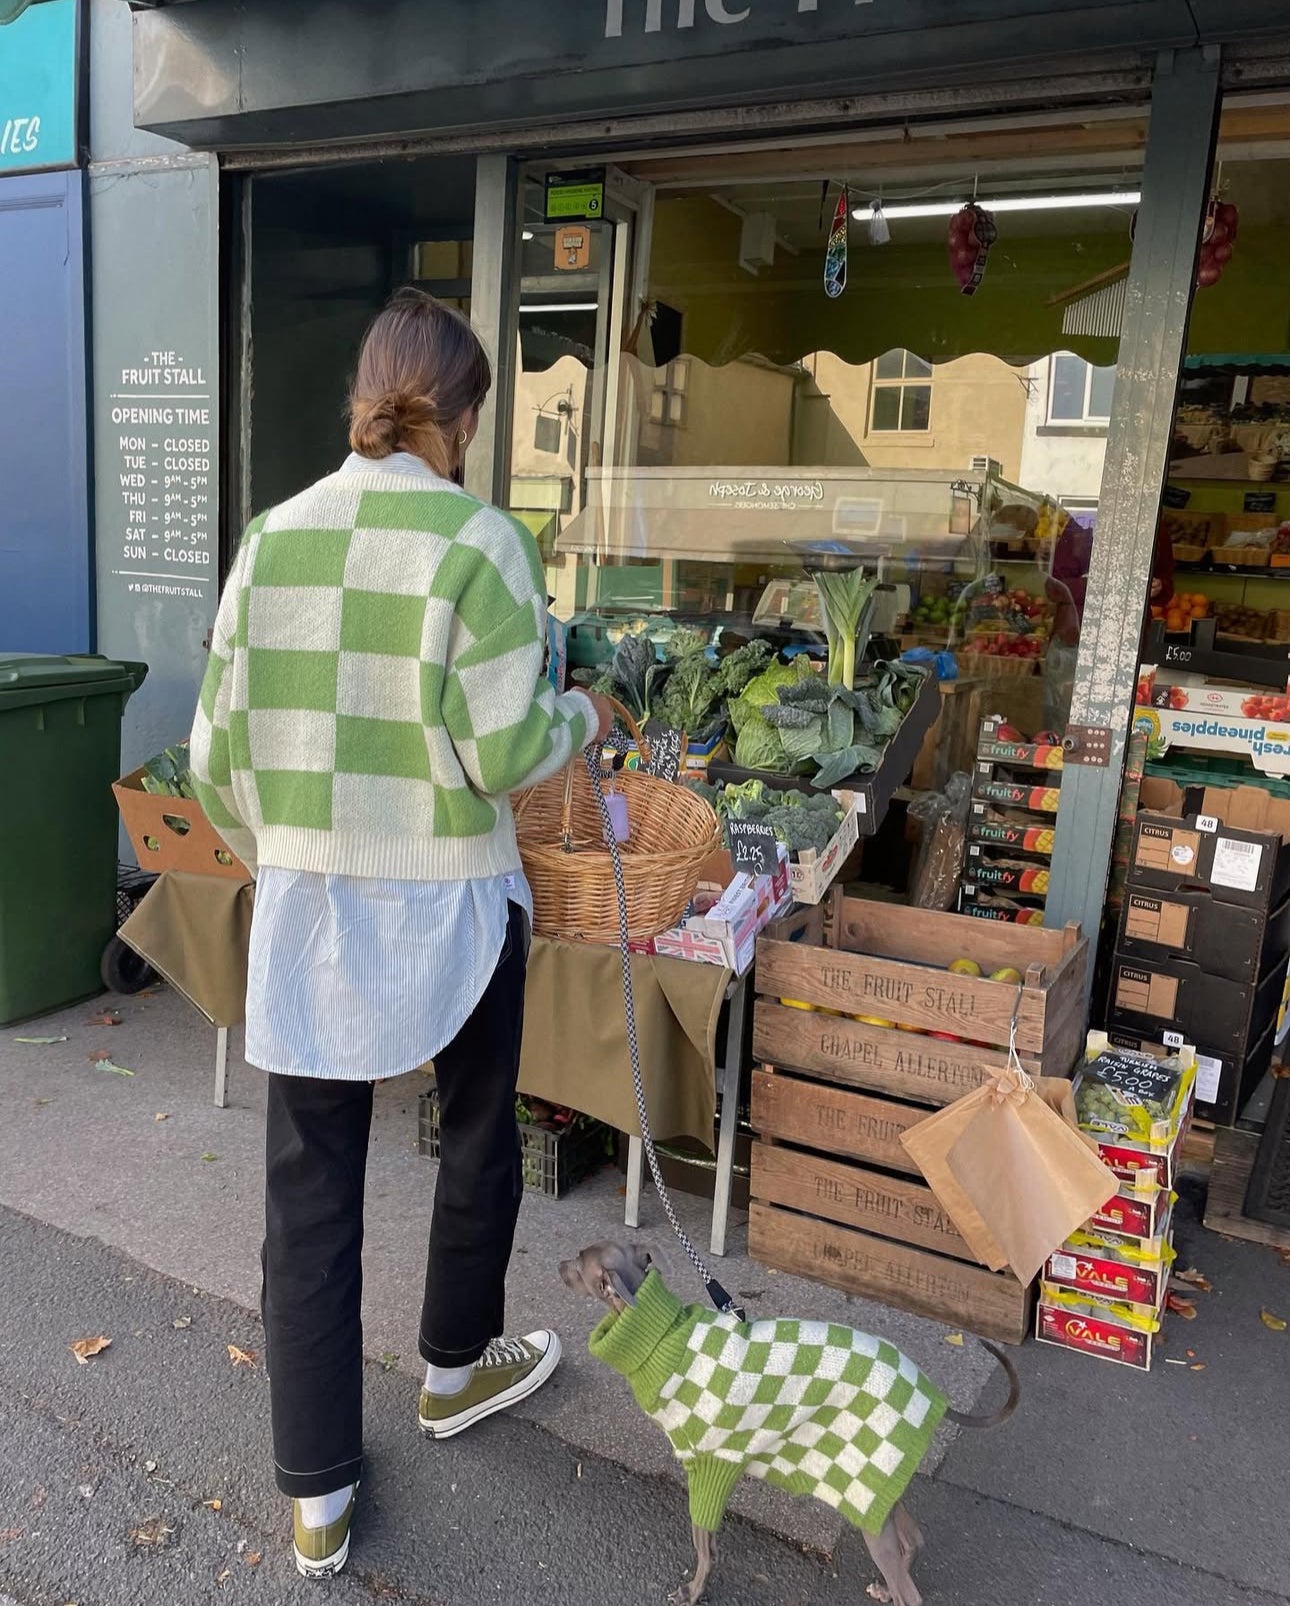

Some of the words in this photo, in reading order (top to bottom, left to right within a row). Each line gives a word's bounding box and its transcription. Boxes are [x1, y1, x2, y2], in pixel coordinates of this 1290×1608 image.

[151, 351, 176, 366] THE
[122, 368, 161, 385] FRUIT
[163, 367, 207, 385] STALL
[111, 407, 173, 425] OPENING
[175, 408, 210, 425] TIME
[119, 436, 146, 450] MON
[164, 438, 210, 452] CLOSED
[124, 455, 146, 469] TUE
[164, 456, 210, 471] CLOSED
[120, 474, 146, 487] WED
[122, 491, 146, 506] THU
[129, 510, 146, 523] FRI
[125, 527, 146, 541] SAT
[123, 545, 146, 559] SUN
[164, 547, 210, 564] CLOSED
[141, 583, 204, 598] @THEFRUITSTALL
[1165, 645, 1192, 662] £5.00
[1172, 720, 1266, 743] pineapples
[990, 744, 1030, 760] fruitfy
[986, 786, 1025, 801] fruitfy
[730, 822, 774, 836] RASPBERRIES
[1201, 818, 1214, 829] 48
[980, 827, 1019, 842] fruitfy
[1144, 827, 1169, 838] CITRUS
[736, 840, 765, 863] £2.25
[977, 868, 1015, 884] fruitfy
[1133, 899, 1158, 910] CITRUS
[972, 907, 1010, 921] fruitfy
[1123, 970, 1148, 982] CITRUS
[820, 966, 851, 991] THE
[863, 973, 914, 1004] FRUIT
[924, 986, 980, 1018] STALL
[1113, 1037, 1138, 1048] CITRUS
[1167, 1034, 1180, 1045] 48
[820, 1034, 883, 1068] CHAPEL
[894, 1051, 983, 1088] ALLERTON
[1097, 1056, 1129, 1070] RAISIN
[1133, 1067, 1171, 1082] GRAPES
[1096, 1066, 1153, 1089] £5.00
[816, 1104, 846, 1131] THE
[1102, 1157, 1140, 1169] ALE
[814, 1176, 844, 1203] THE
[855, 1186, 903, 1220] FRUIT
[912, 1205, 961, 1237] STAL
[1077, 1266, 1129, 1288] VALE
[1070, 1324, 1121, 1346] VALE
